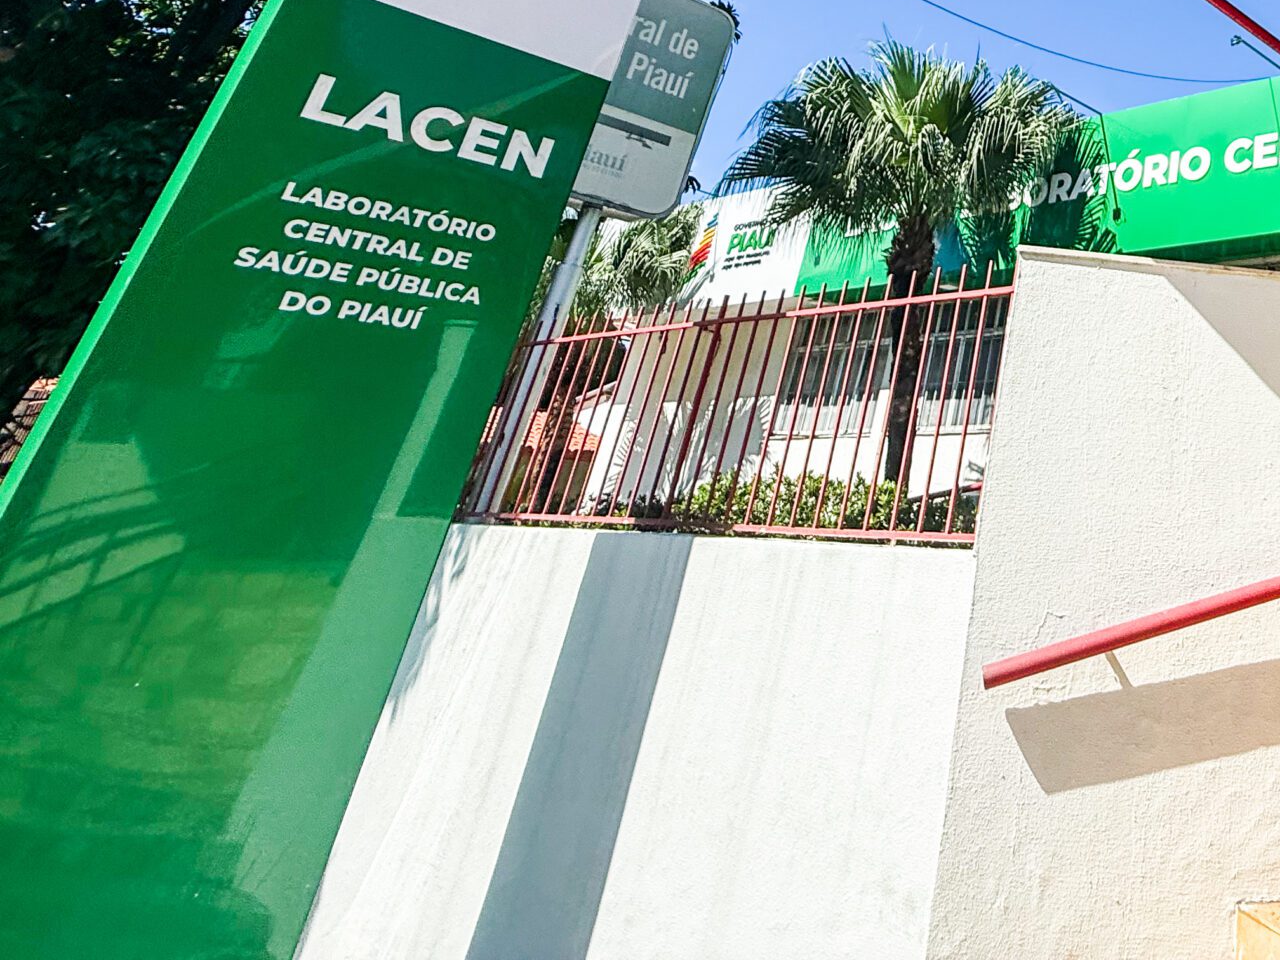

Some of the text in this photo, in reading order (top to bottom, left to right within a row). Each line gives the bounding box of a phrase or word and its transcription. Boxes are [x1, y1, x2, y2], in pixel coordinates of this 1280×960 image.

[629, 15, 699, 60] ral de
[626, 51, 695, 99] Piauí
[300, 73, 555, 179] LACEN
[584, 145, 628, 172] iauí
[281, 181, 496, 241] LABORATÓRIO
[283, 218, 473, 271] CENTRAL DE
[233, 246, 480, 306] SAÚDE PÚBLICA
[278, 290, 428, 330] DO PIAUÍ
